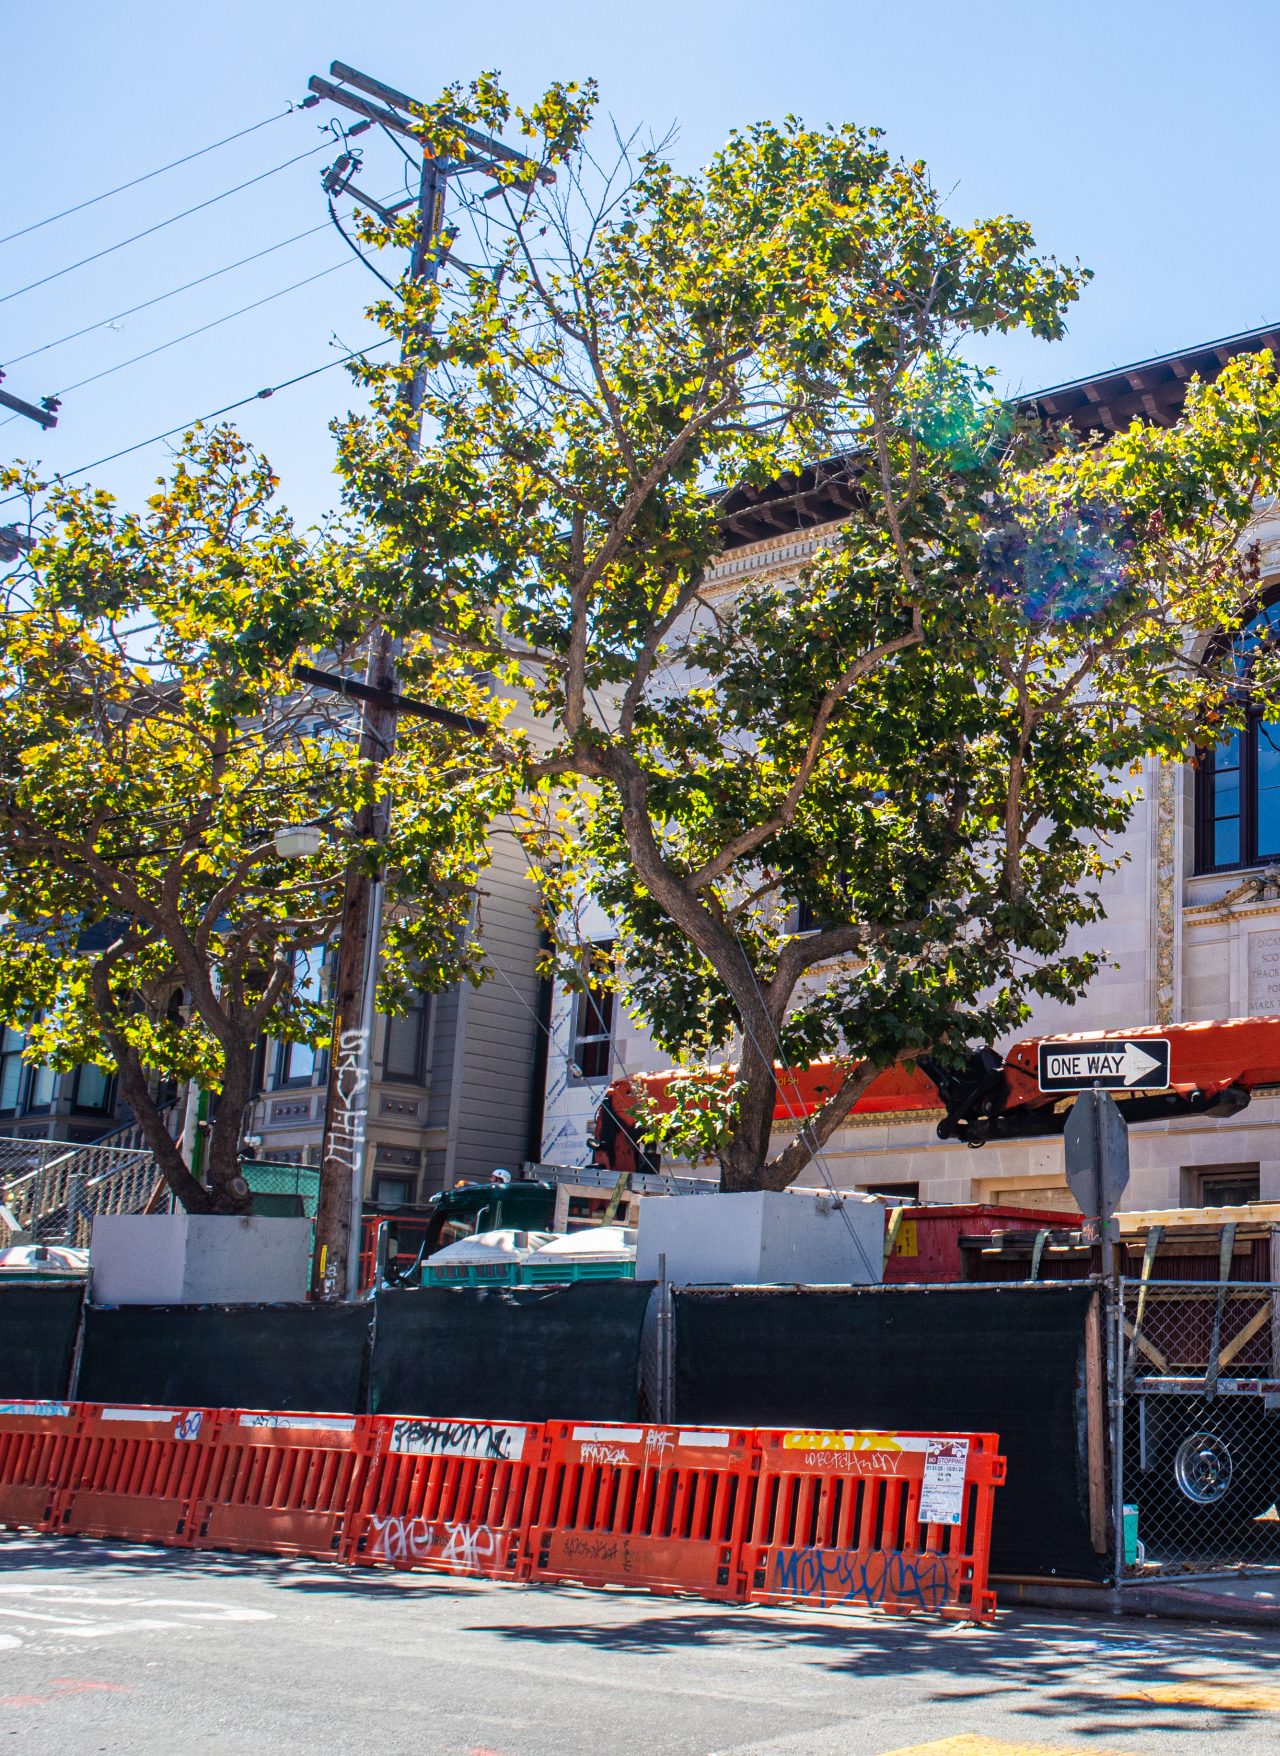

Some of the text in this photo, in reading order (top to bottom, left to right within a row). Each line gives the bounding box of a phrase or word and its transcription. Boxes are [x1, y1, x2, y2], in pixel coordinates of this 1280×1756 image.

[1249, 1000, 1275, 1011] MARK
[1051, 1055, 1124, 1076] ONE WAY
[937, 1456, 965, 1465] STOPPING
